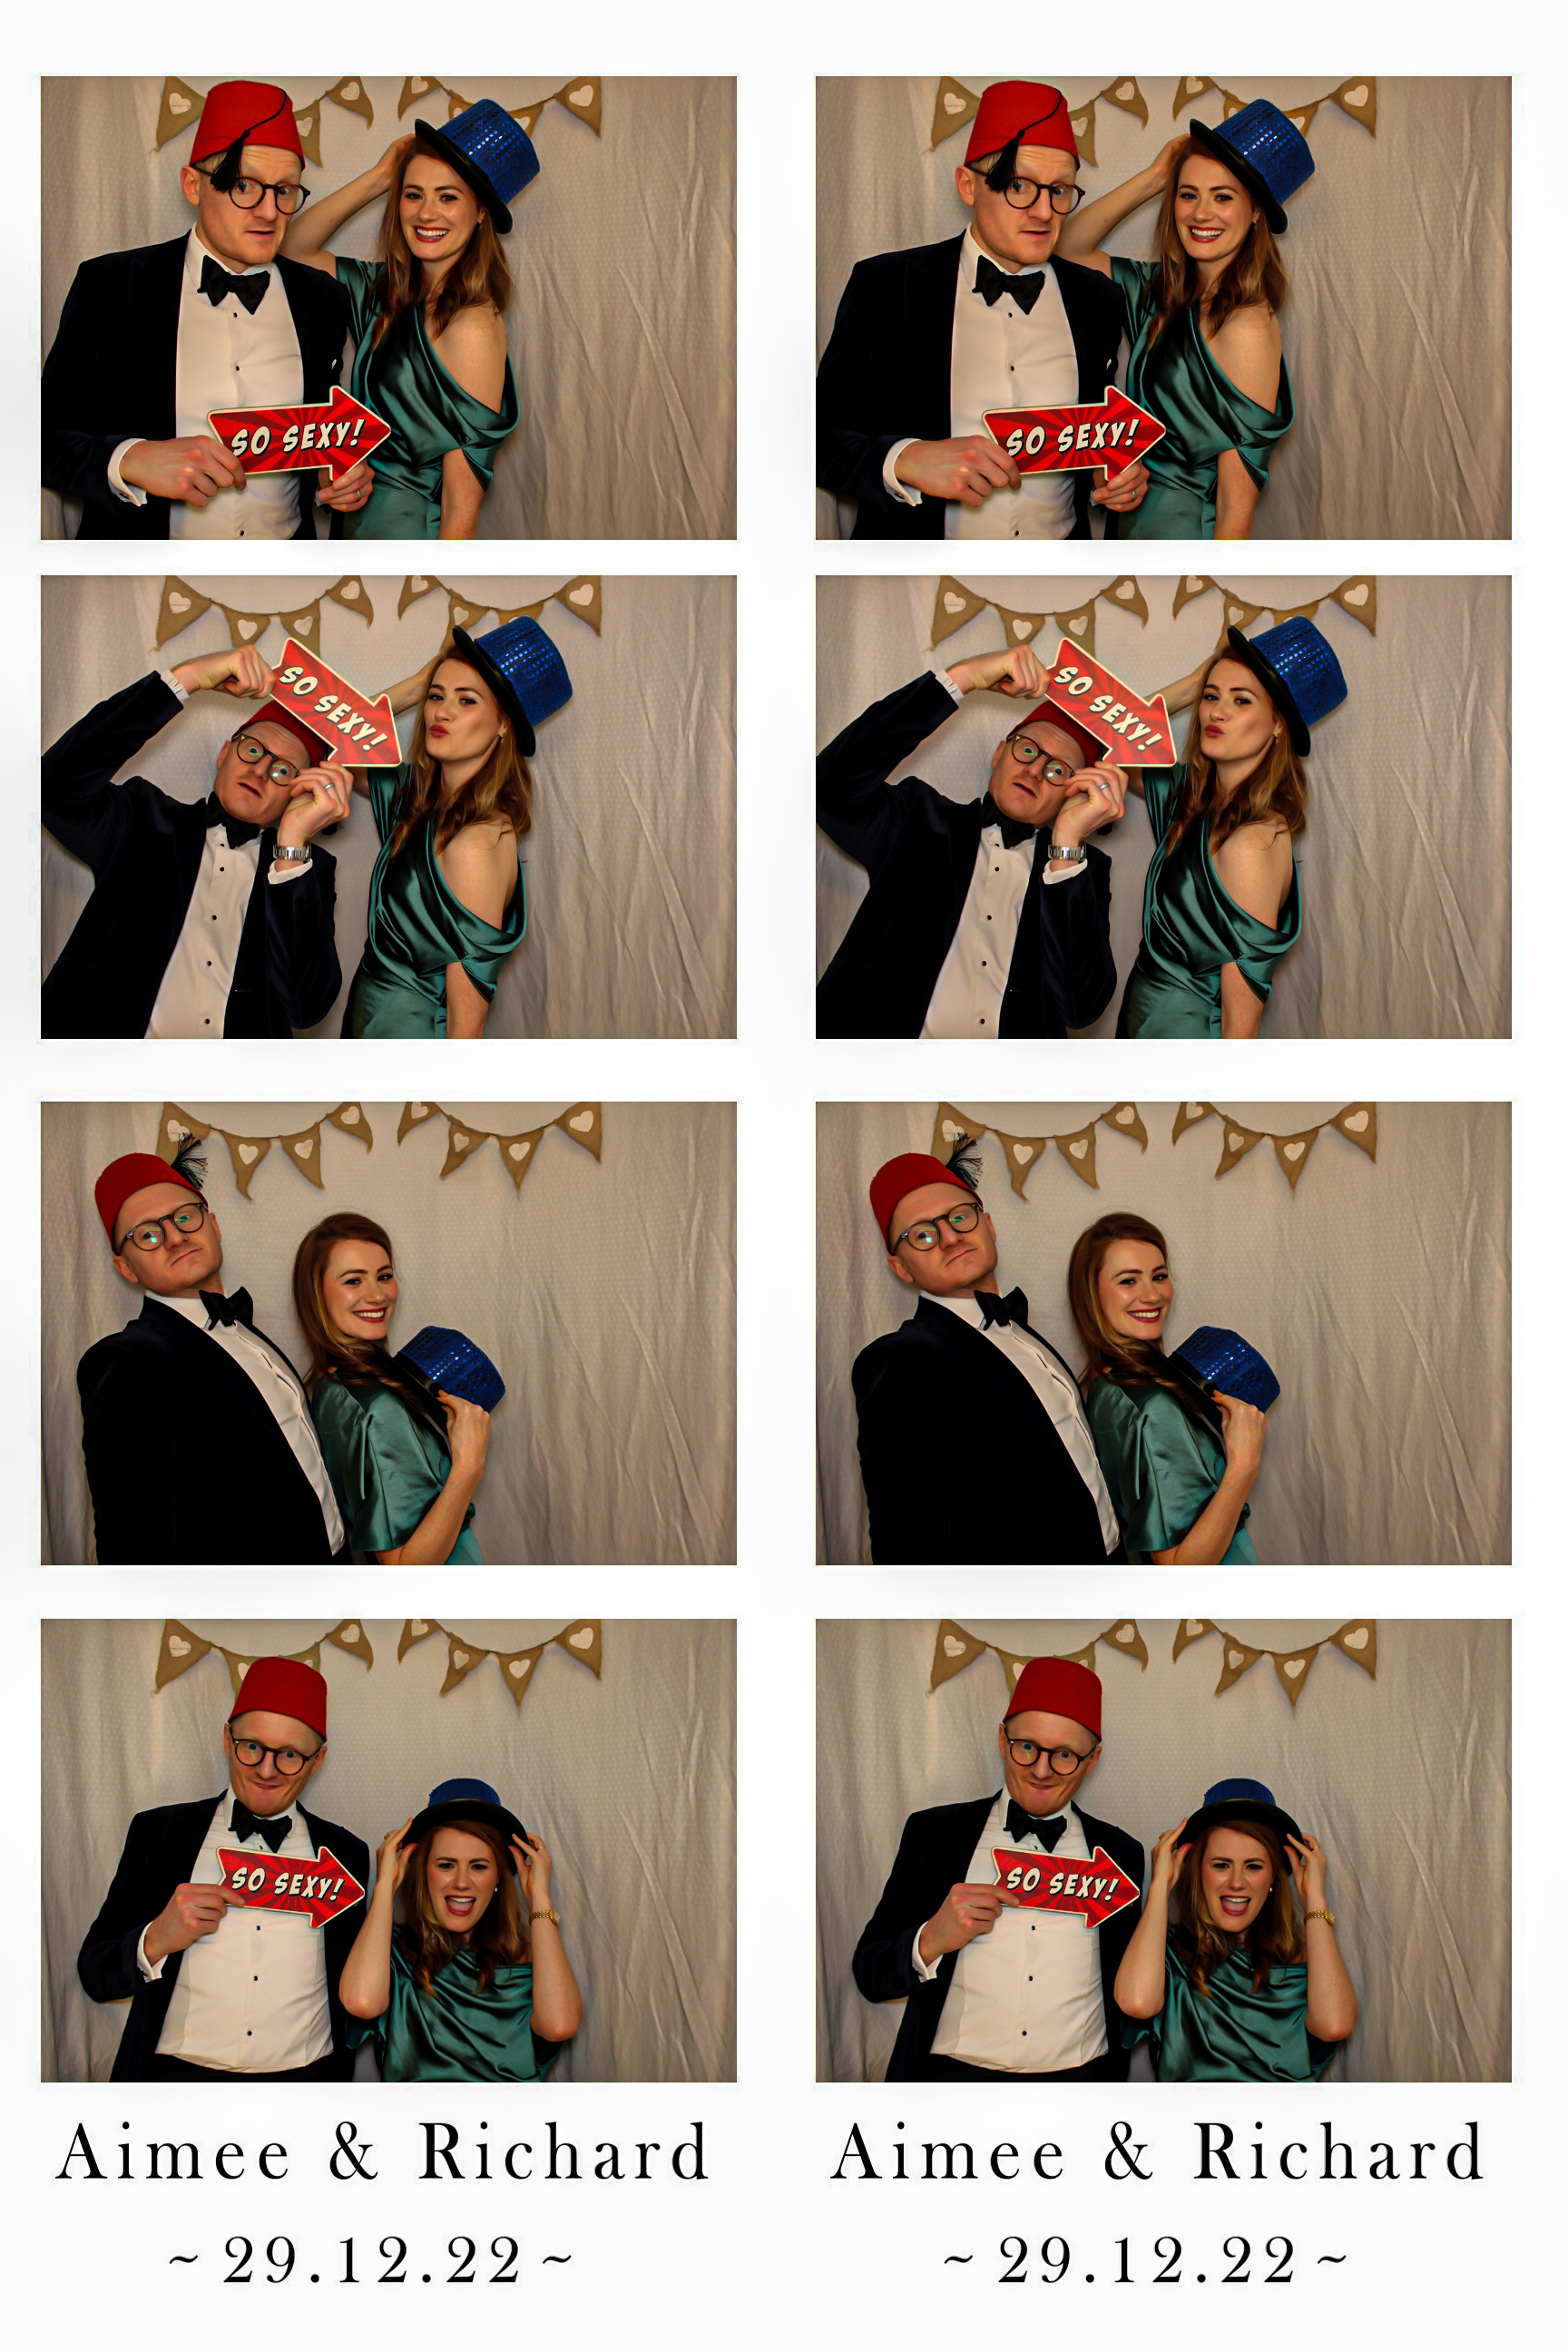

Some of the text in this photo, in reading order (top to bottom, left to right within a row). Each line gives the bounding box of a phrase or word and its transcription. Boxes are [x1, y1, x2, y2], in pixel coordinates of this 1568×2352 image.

[231, 418, 365, 457] SO SEXY!
[1006, 418, 1140, 457] SO SEXY!
[279, 666, 388, 752] SO SEXY!
[1054, 666, 1163, 752] SO SEXY!
[231, 1867, 344, 1902] SO SEXY!
[1006, 1867, 1119, 1902] SO SEXY!
